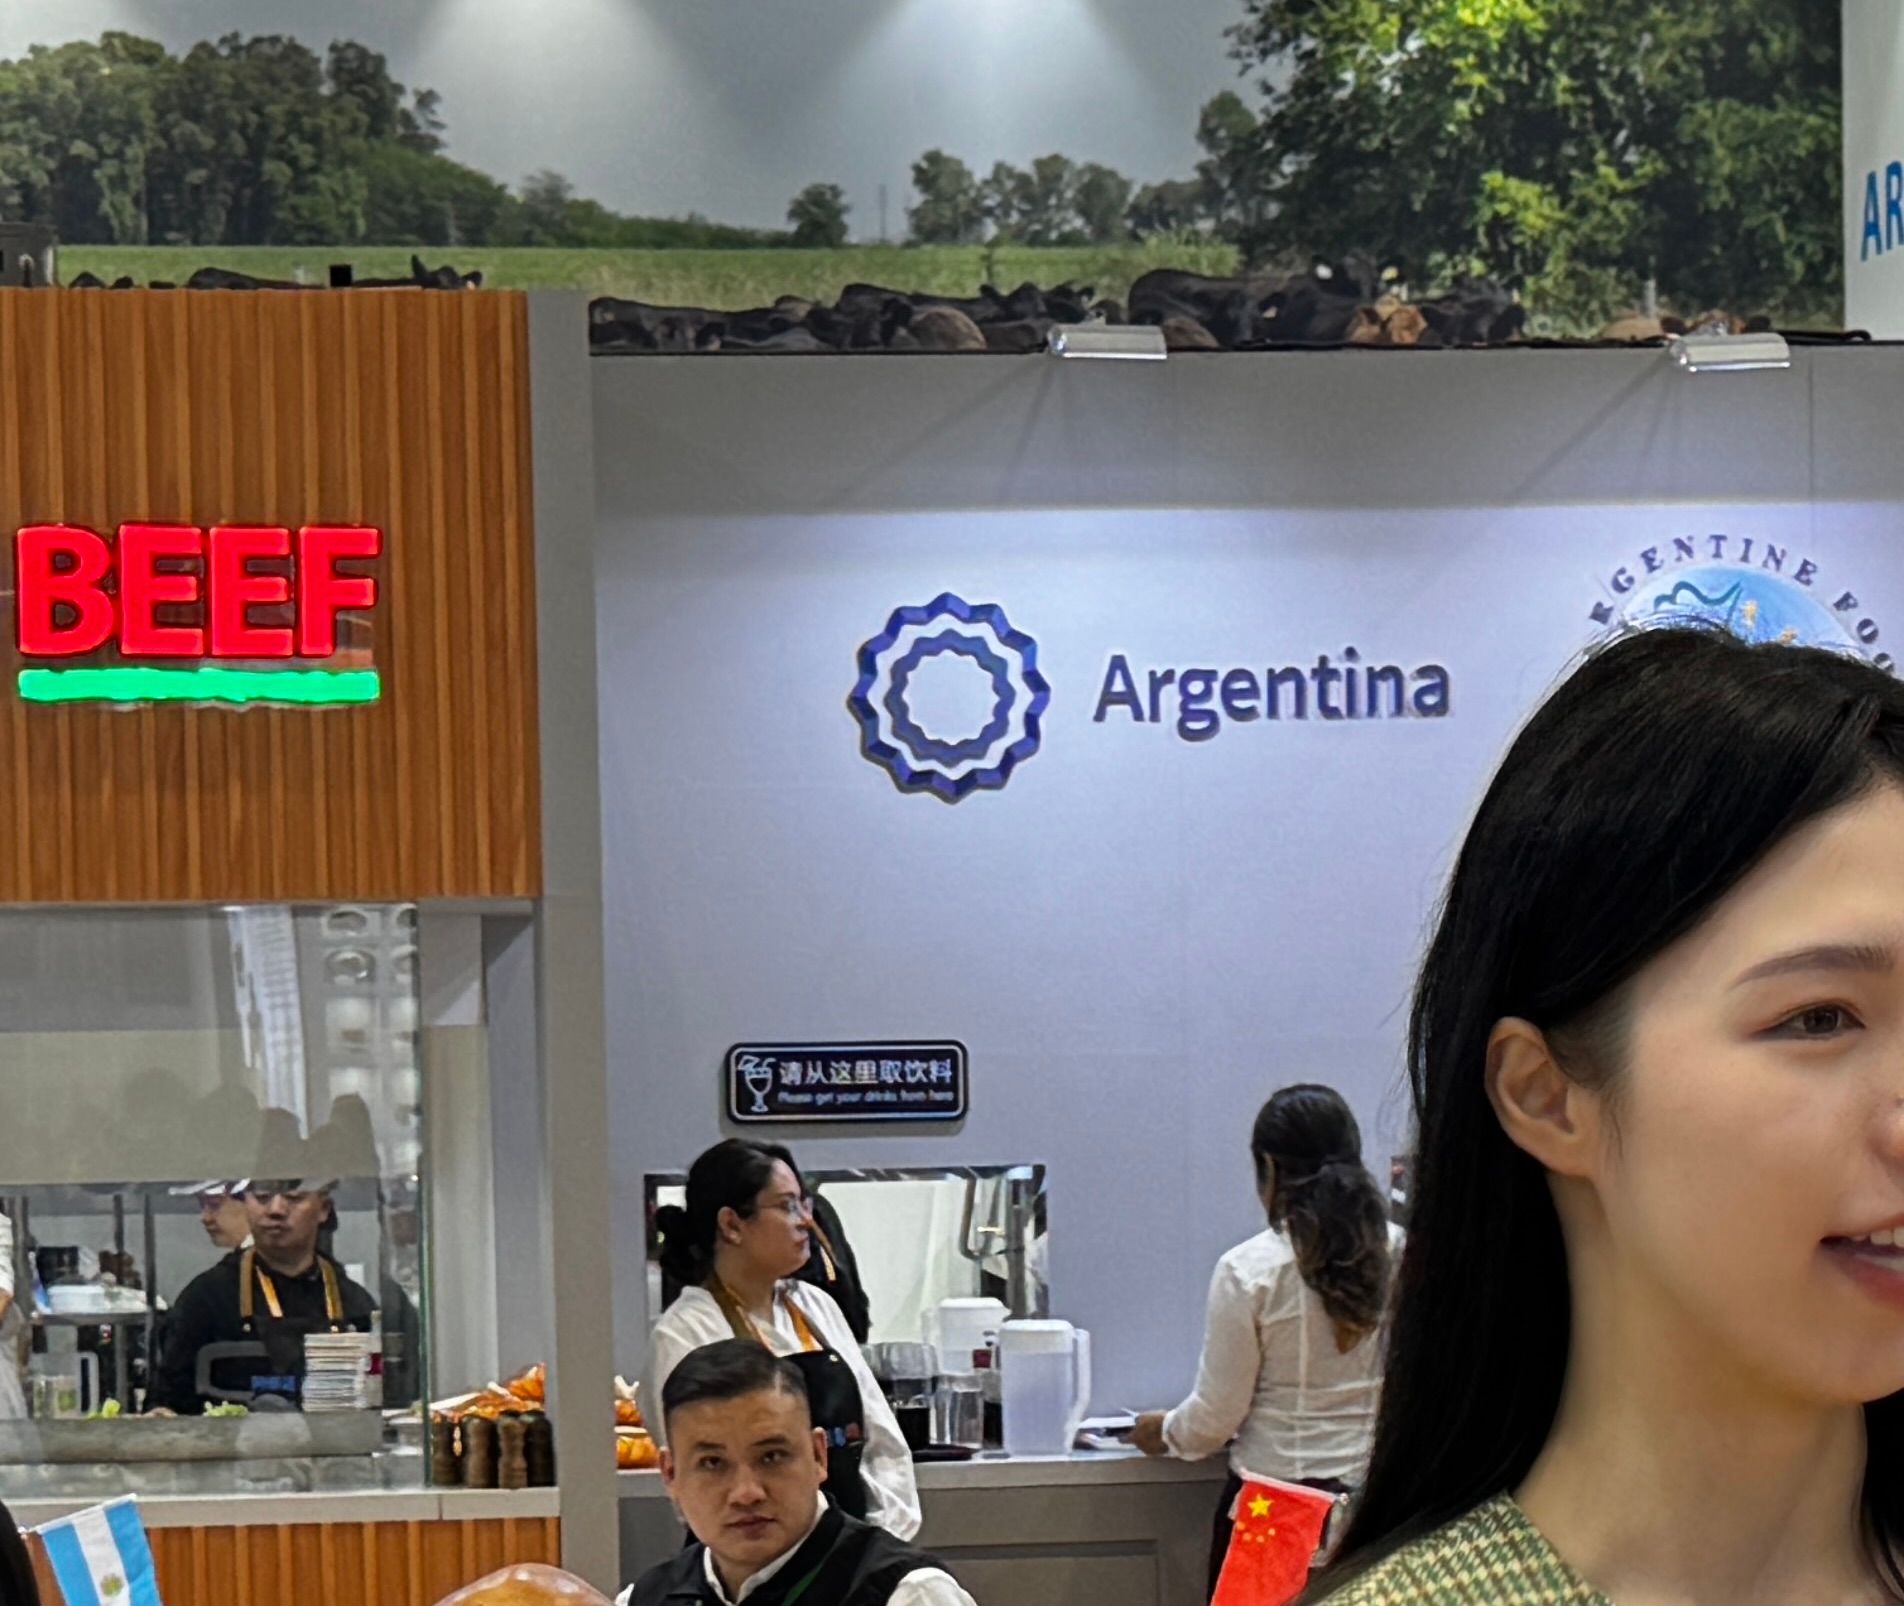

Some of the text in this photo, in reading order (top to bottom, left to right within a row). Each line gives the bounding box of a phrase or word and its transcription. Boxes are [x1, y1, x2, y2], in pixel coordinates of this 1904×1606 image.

[15, 523, 383, 658] BEEF
[1589, 534, 1894, 672] RGENTINE FOO
[1094, 649, 1451, 743] Argentina
[779, 1059, 952, 1085] 请从这里取饮料
